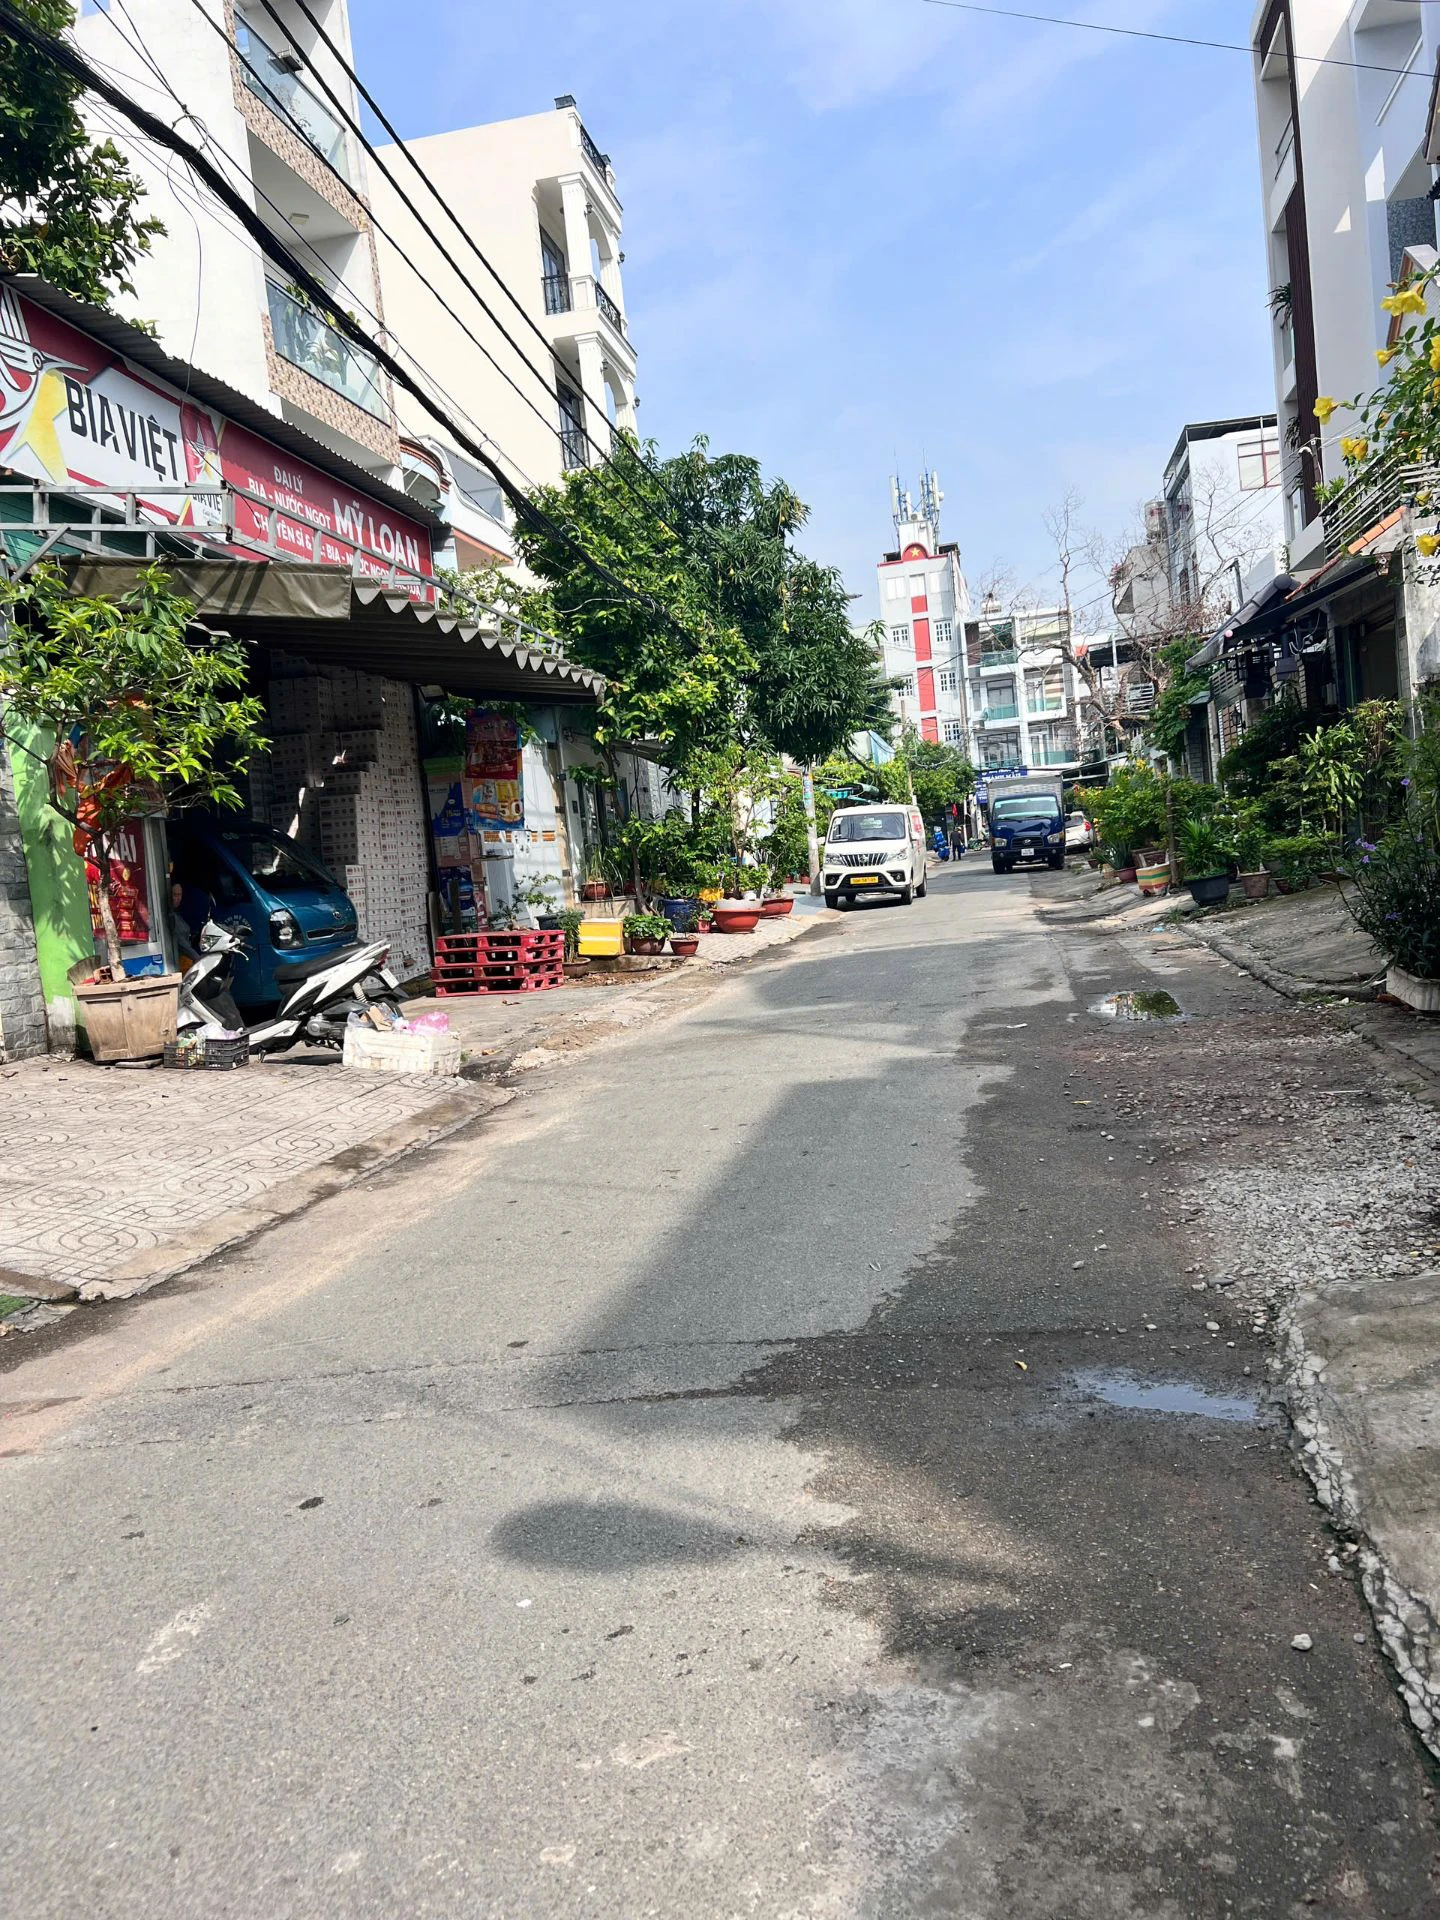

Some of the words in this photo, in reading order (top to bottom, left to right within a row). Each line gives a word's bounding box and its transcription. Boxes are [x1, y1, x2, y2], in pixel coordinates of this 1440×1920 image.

[247, 477, 267, 499] BIA
[273, 465, 292, 490] ĐẠI
[292, 474, 303, 494] LÝ
[253, 511, 296, 544] CHYÊN
[333, 498, 364, 546] MỸ
[368, 516, 421, 573] LOAN
